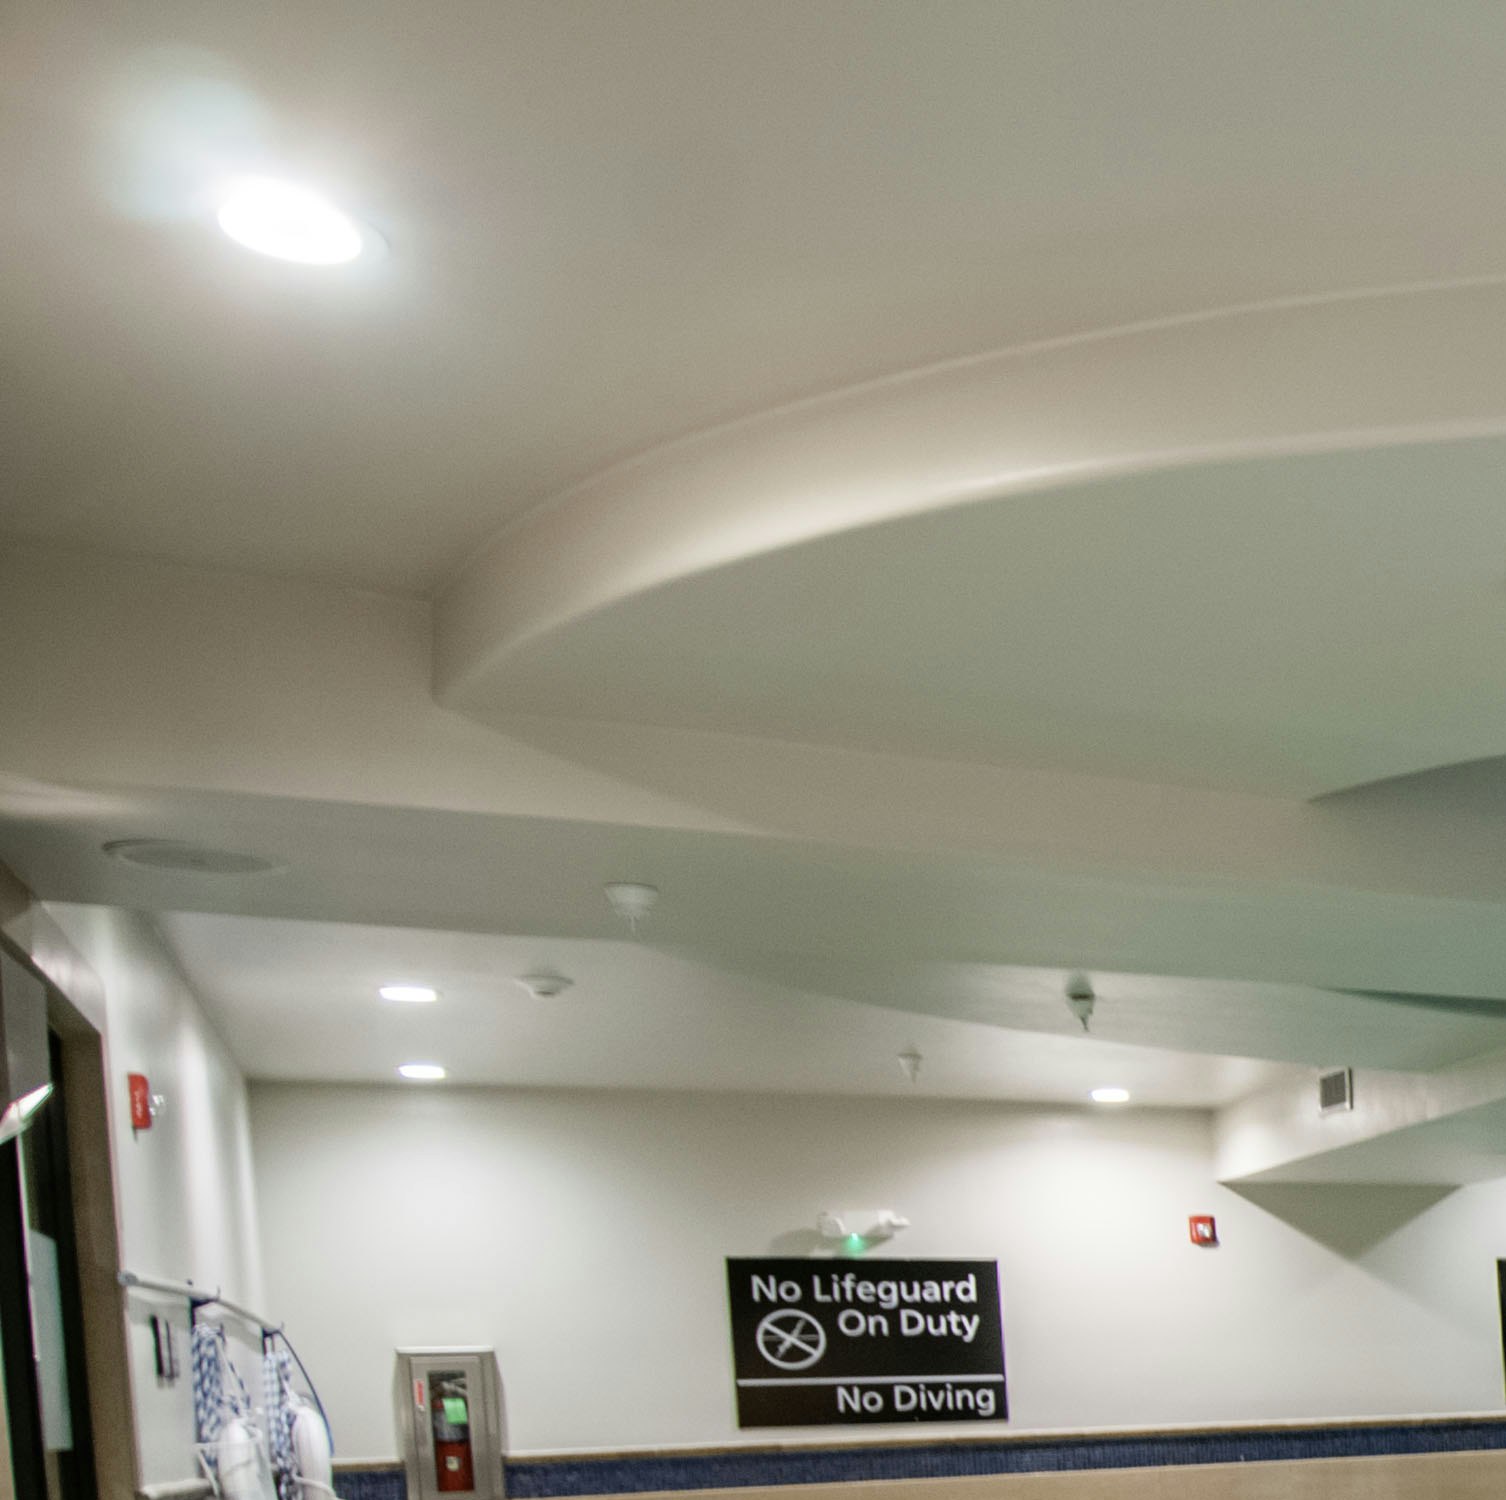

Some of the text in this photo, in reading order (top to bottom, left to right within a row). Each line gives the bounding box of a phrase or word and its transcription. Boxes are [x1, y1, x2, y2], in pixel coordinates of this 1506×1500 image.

[751, 1273, 977, 1309] No Lifeguard
[837, 1308, 980, 1343] On Duty
[836, 1383, 996, 1417] No Diving
